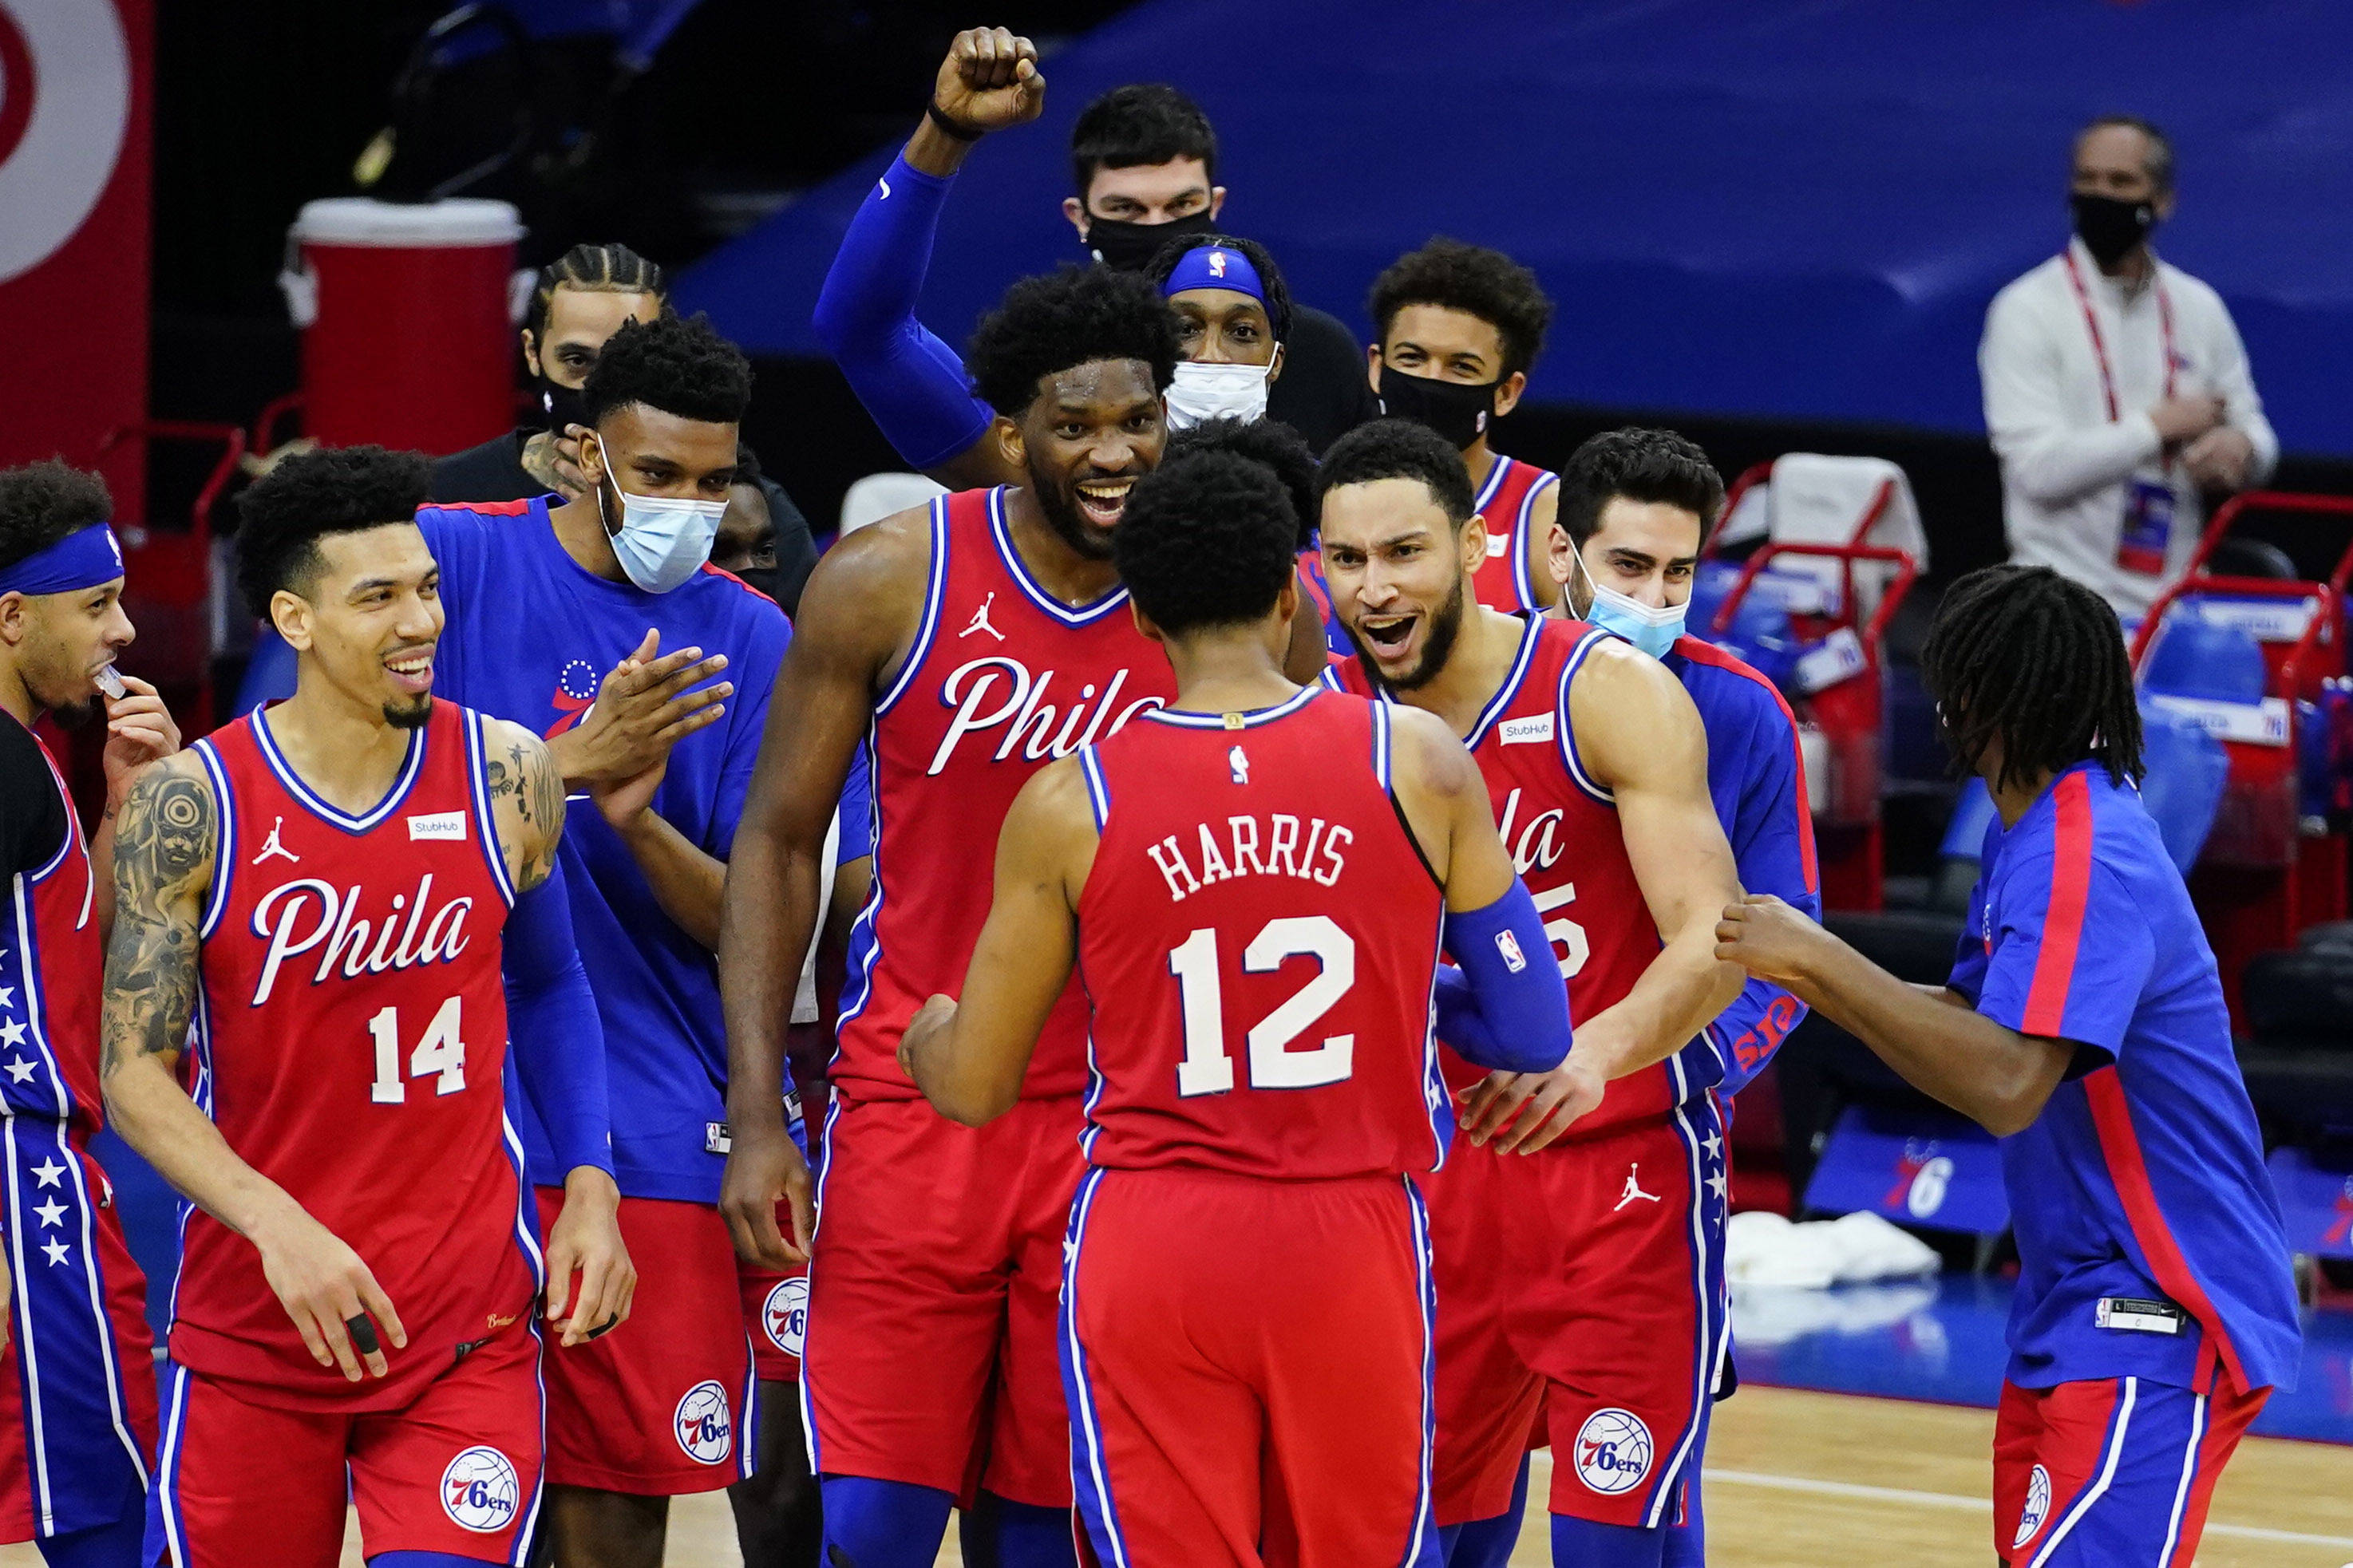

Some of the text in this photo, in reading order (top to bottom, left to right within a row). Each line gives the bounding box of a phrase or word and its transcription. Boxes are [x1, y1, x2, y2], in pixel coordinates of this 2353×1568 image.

[1506, 724, 1549, 737] StubHub
[415, 822, 459, 832] StubHub
[1147, 813, 1354, 902] HARRIS
[249, 873, 473, 1008] Phila
[1529, 882, 1590, 980] 5
[368, 995, 467, 1104] 14
[1168, 915, 1355, 1100] 12
[451, 1477, 512, 1513] 76ers
[1581, 1437, 1643, 1475] 76ers
